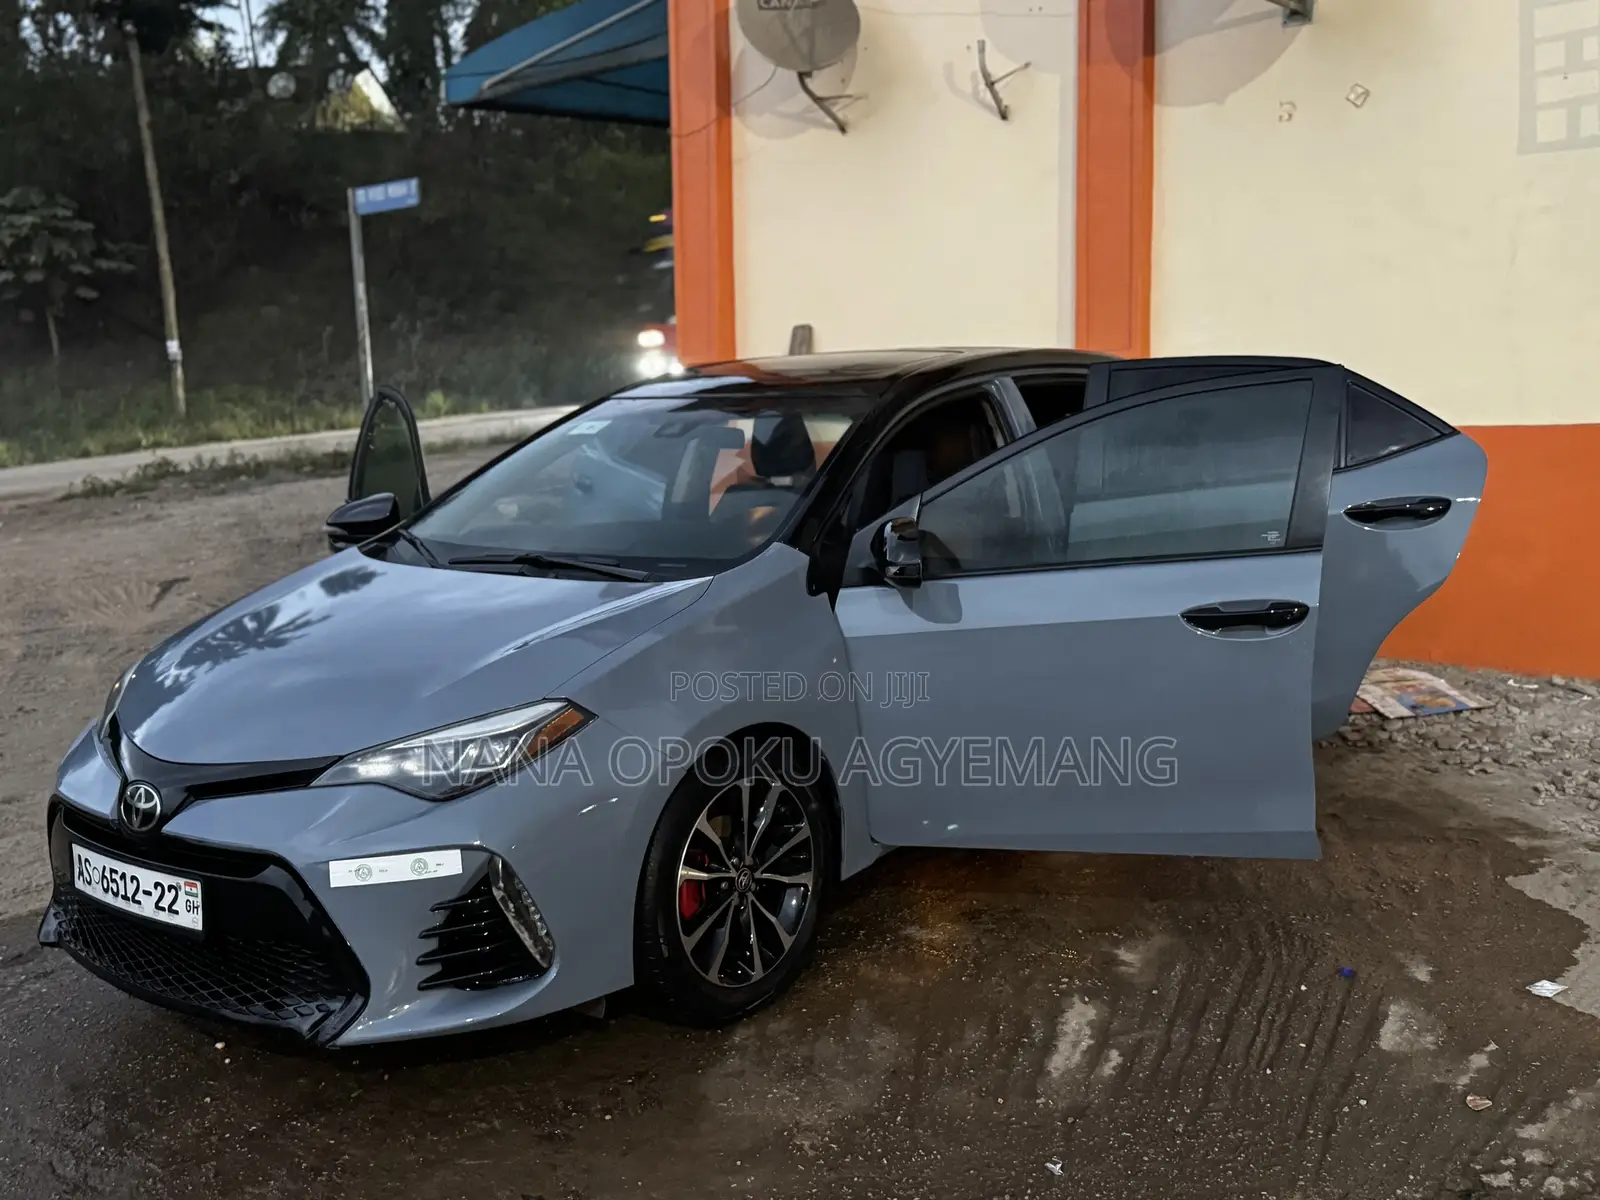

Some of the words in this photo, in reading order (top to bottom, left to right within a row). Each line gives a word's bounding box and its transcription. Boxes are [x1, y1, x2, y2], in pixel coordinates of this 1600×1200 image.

[77, 854, 92, 886] AS
[101, 865, 180, 916] 6512-22
[185, 899, 200, 915] GH
